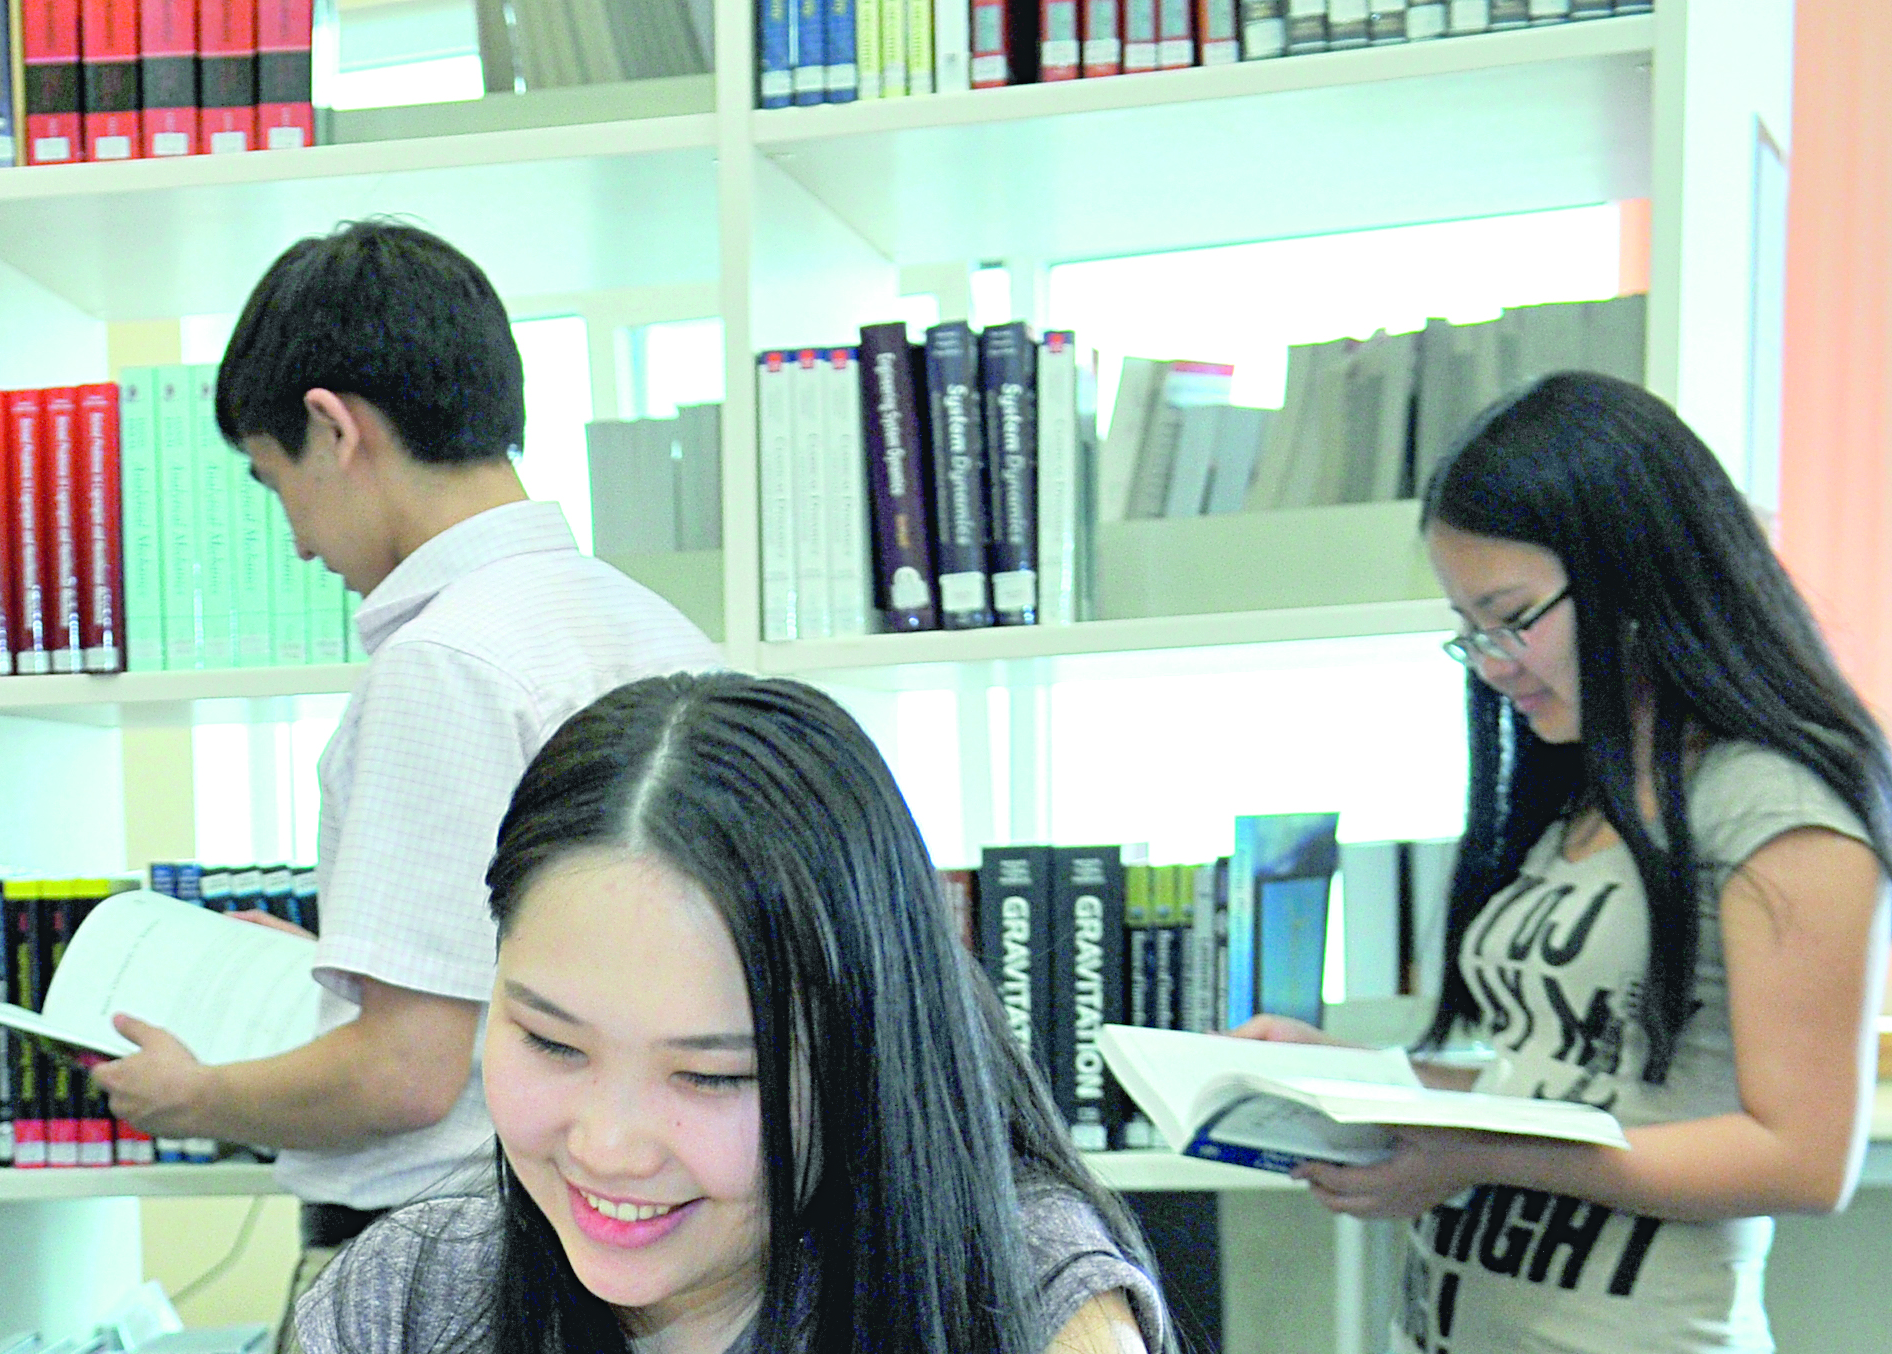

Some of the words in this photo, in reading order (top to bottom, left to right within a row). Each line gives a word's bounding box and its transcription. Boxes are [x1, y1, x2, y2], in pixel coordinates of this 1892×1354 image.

[875, 352, 899, 411] Engineering
[881, 412, 904, 446] System
[944, 384, 969, 452] System
[997, 383, 1023, 451] System
[884, 448, 907, 496] Dynamics
[948, 455, 974, 546] Dynamics
[1003, 454, 1027, 545] Dynamics
[135, 531, 151, 598] Mechanics
[173, 532, 188, 596] Mechanics
[208, 531, 224, 596] Mechanics
[242, 528, 257, 591] Mechanics
[1002, 896, 1032, 1056] GRAVITAT
[1074, 895, 1104, 1099] GRAVITATION
[1412, 1183, 1664, 1297] IGHT
